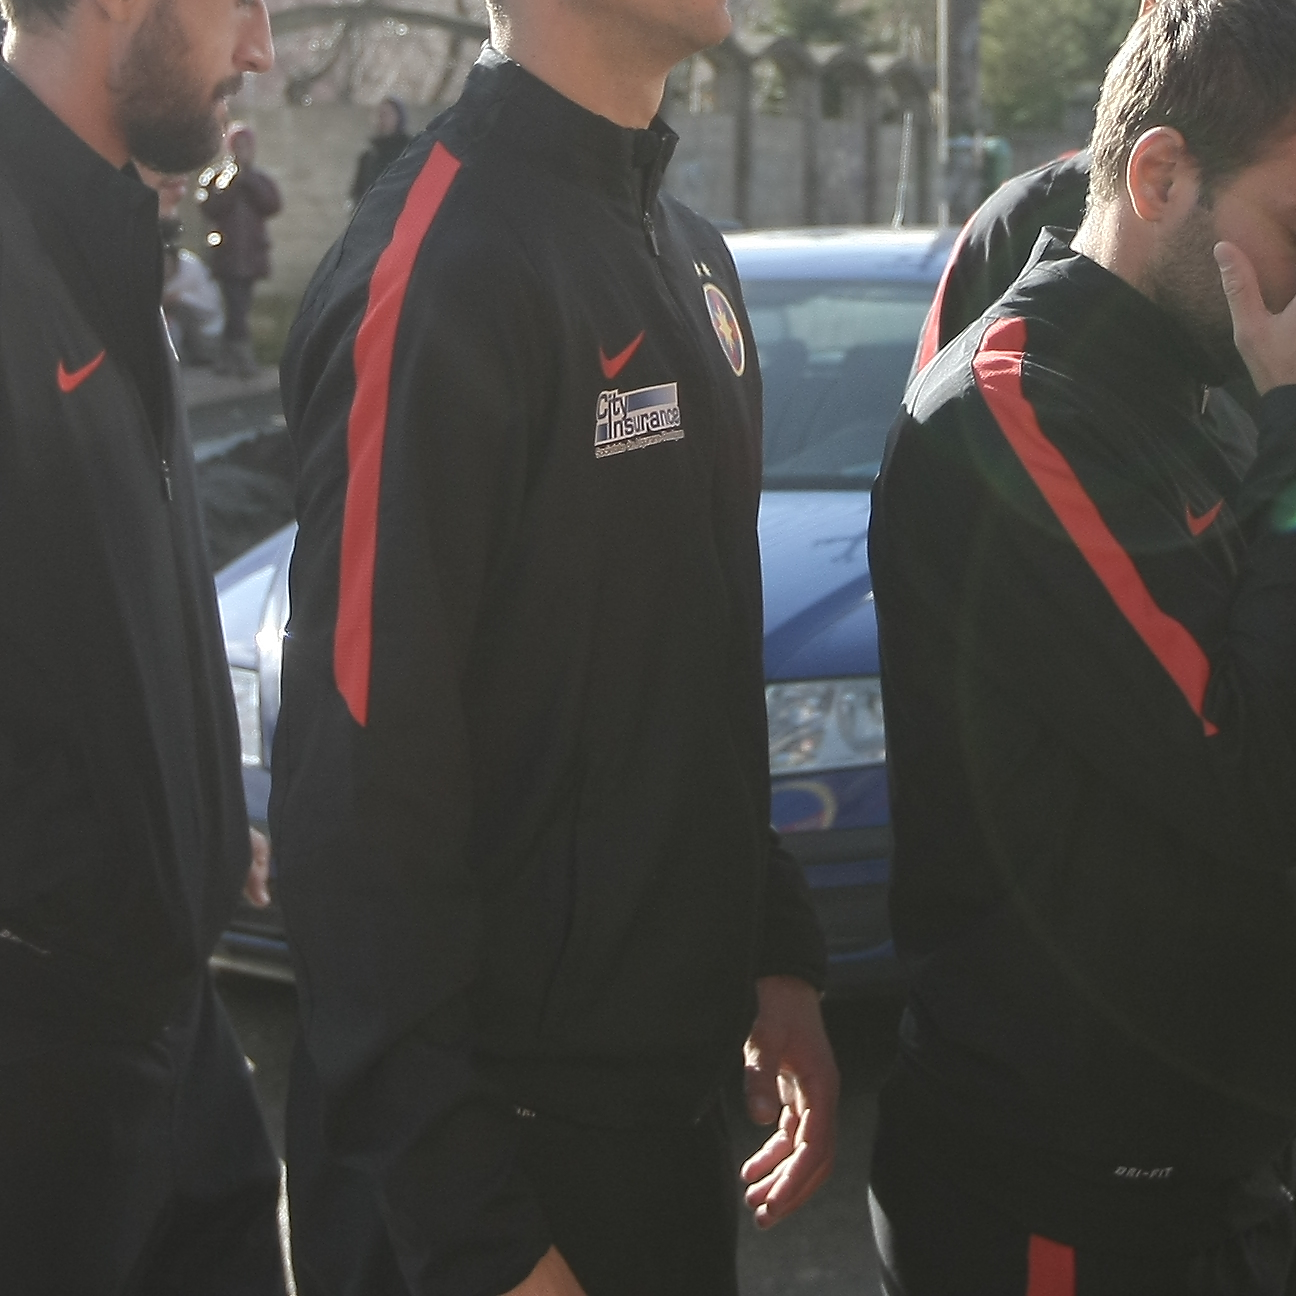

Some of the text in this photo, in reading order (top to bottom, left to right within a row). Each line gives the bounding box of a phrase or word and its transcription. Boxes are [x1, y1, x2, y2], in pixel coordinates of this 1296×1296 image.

[597, 392, 628, 421] City
[608, 407, 680, 440] Insurance
[1114, 1165, 1173, 1178] DRI-FIT
